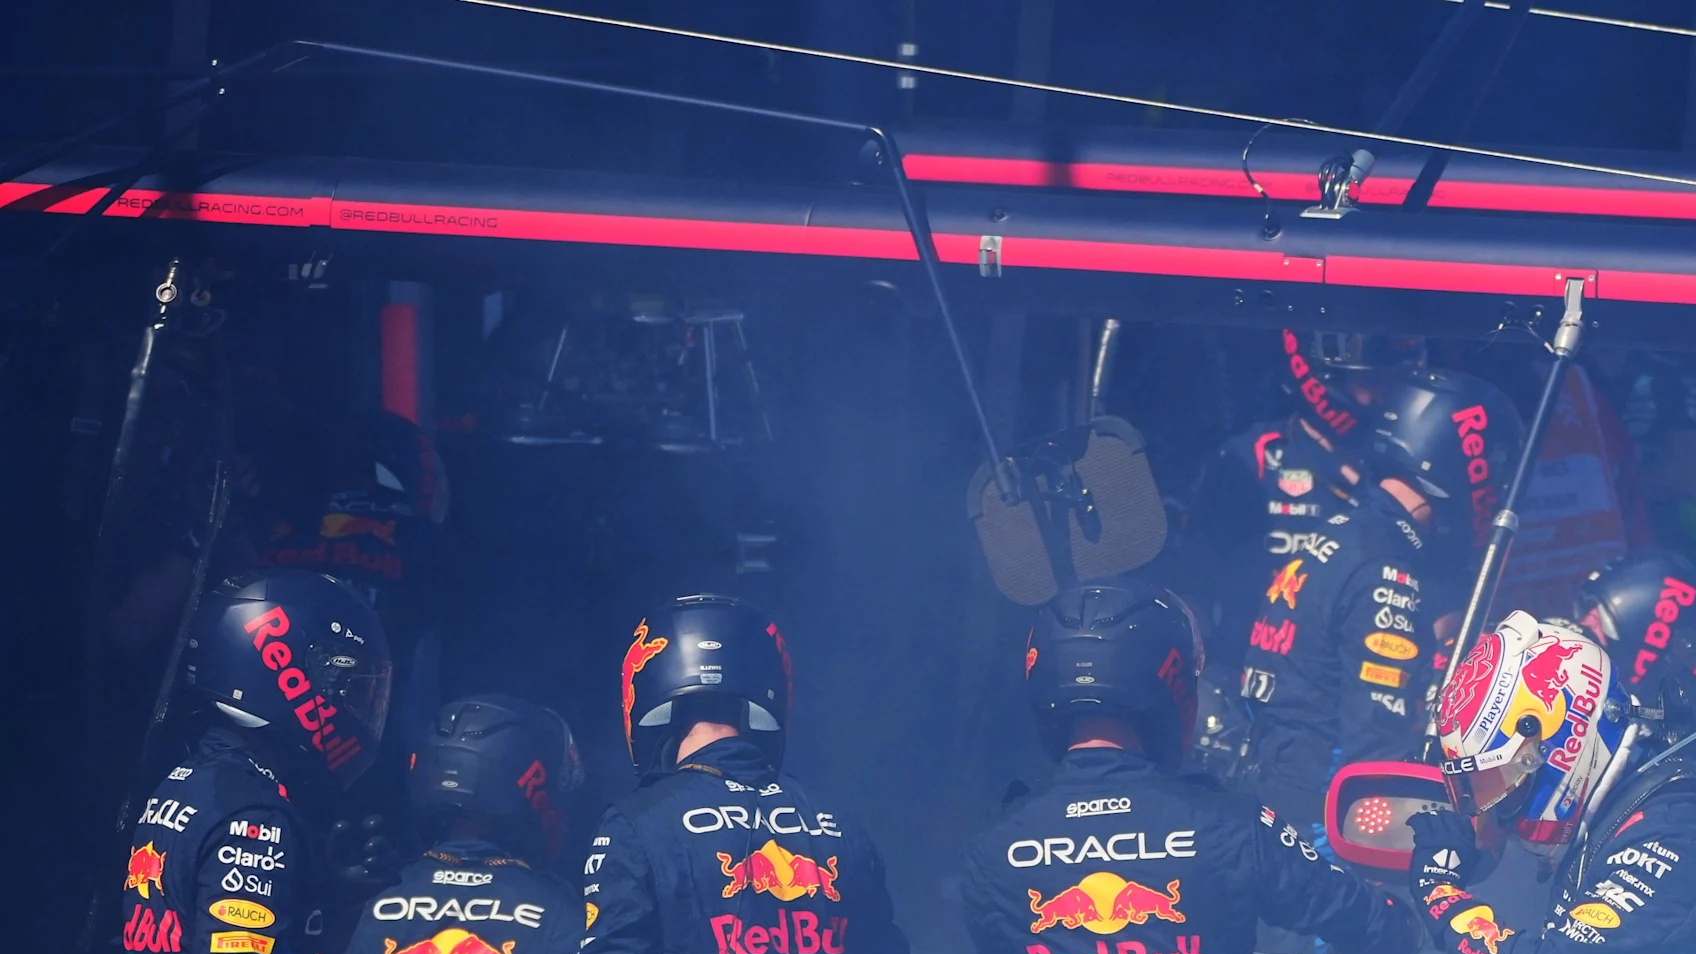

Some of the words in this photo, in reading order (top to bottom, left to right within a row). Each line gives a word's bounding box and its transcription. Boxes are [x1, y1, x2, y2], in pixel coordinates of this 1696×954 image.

[340, 208, 498, 229] @REDBULLRACING
[243, 605, 312, 701] Red
[1480, 687, 1509, 732] Player
[1548, 712, 1590, 774] Red
[1571, 663, 1605, 722] Bull
[1066, 796, 1132, 819] sparco
[229, 820, 282, 845] Mobil
[682, 805, 842, 838] ORACLE
[217, 845, 286, 872] Claro
[1007, 830, 1198, 869] ORACLE
[244, 874, 274, 897] Sui
[432, 869, 494, 887] sparco
[227, 904, 267, 924] RAUCH
[372, 896, 546, 929] ORACLE
